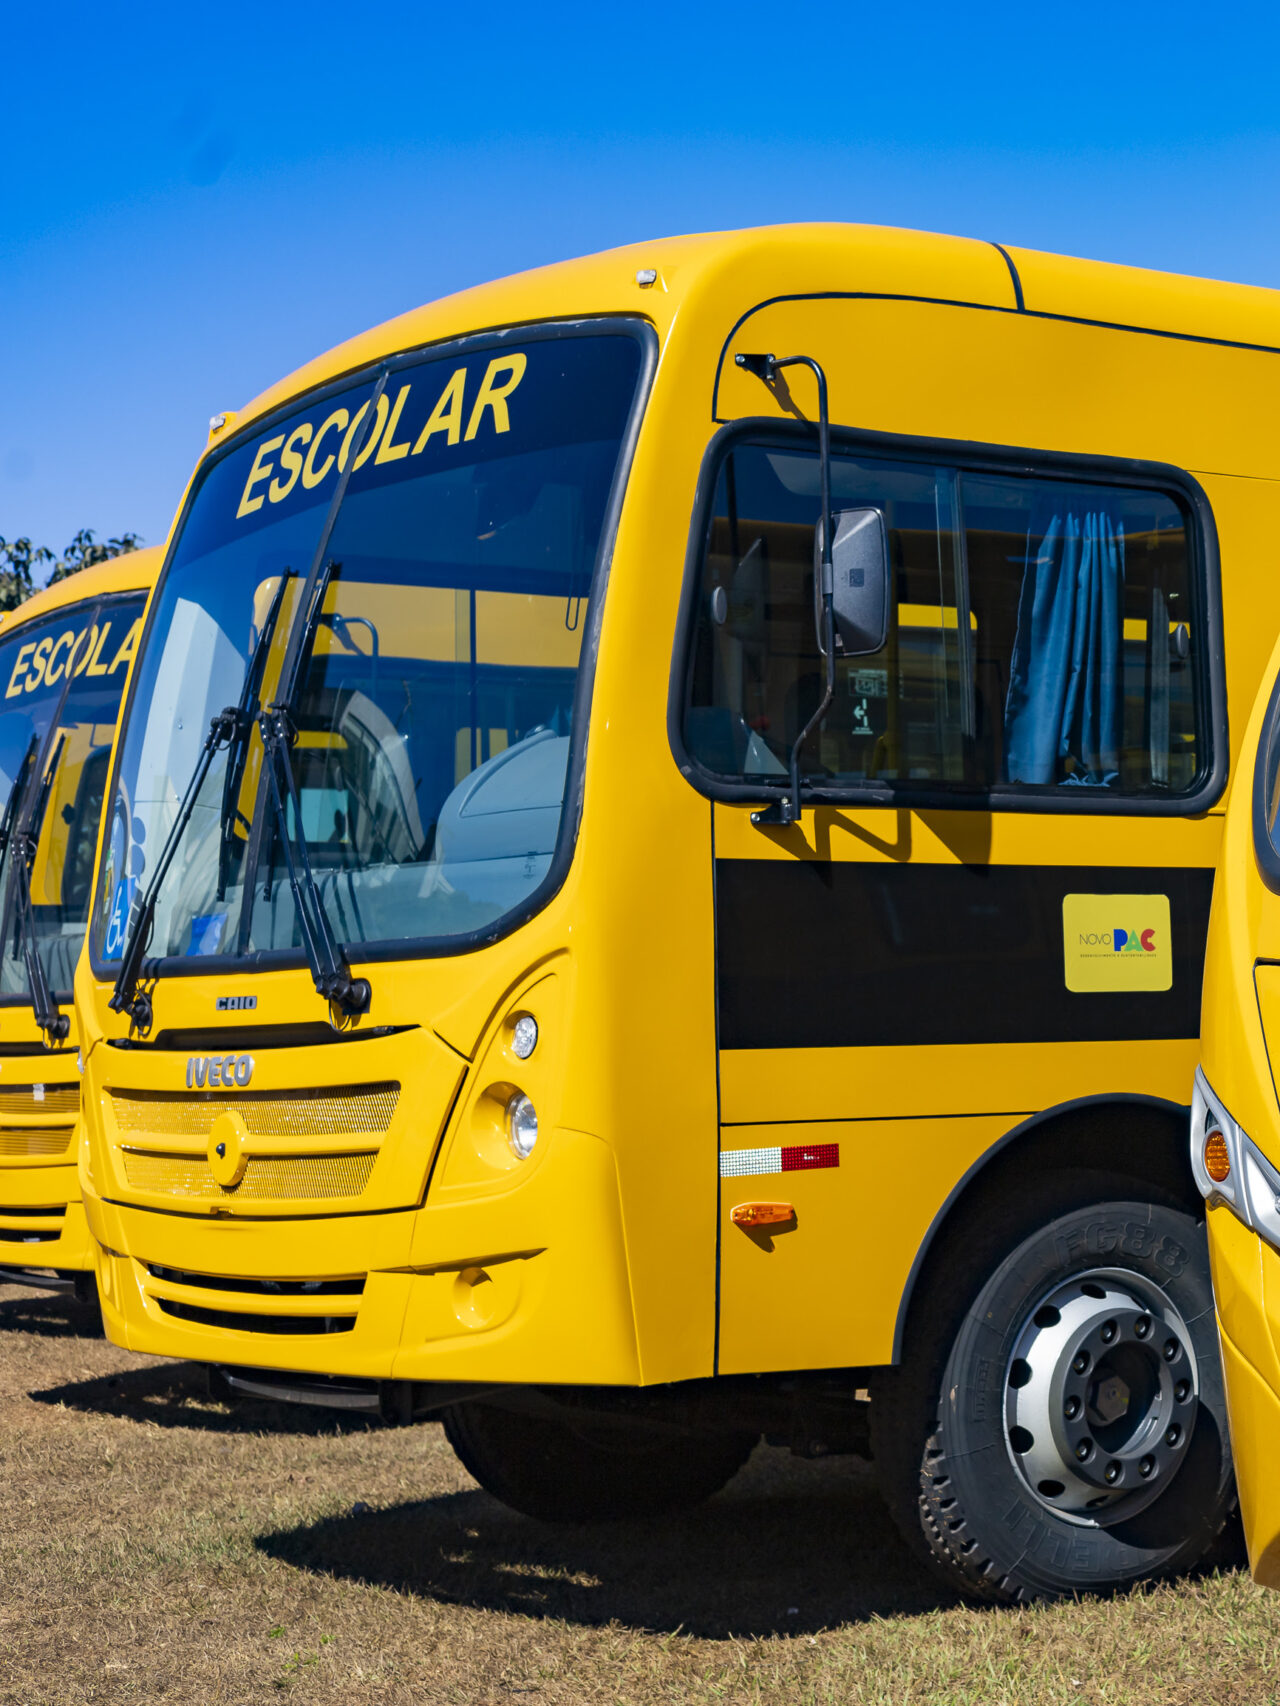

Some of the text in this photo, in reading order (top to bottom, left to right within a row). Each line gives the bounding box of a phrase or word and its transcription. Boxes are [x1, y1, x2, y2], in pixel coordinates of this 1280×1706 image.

[236, 352, 528, 519] ESCOLAR
[1079, 928, 1156, 952] NOVO PAC
[216, 996, 258, 1011] CAIO
[186, 1055, 256, 1089] IVECO
[1054, 1222, 1191, 1277] FG88
